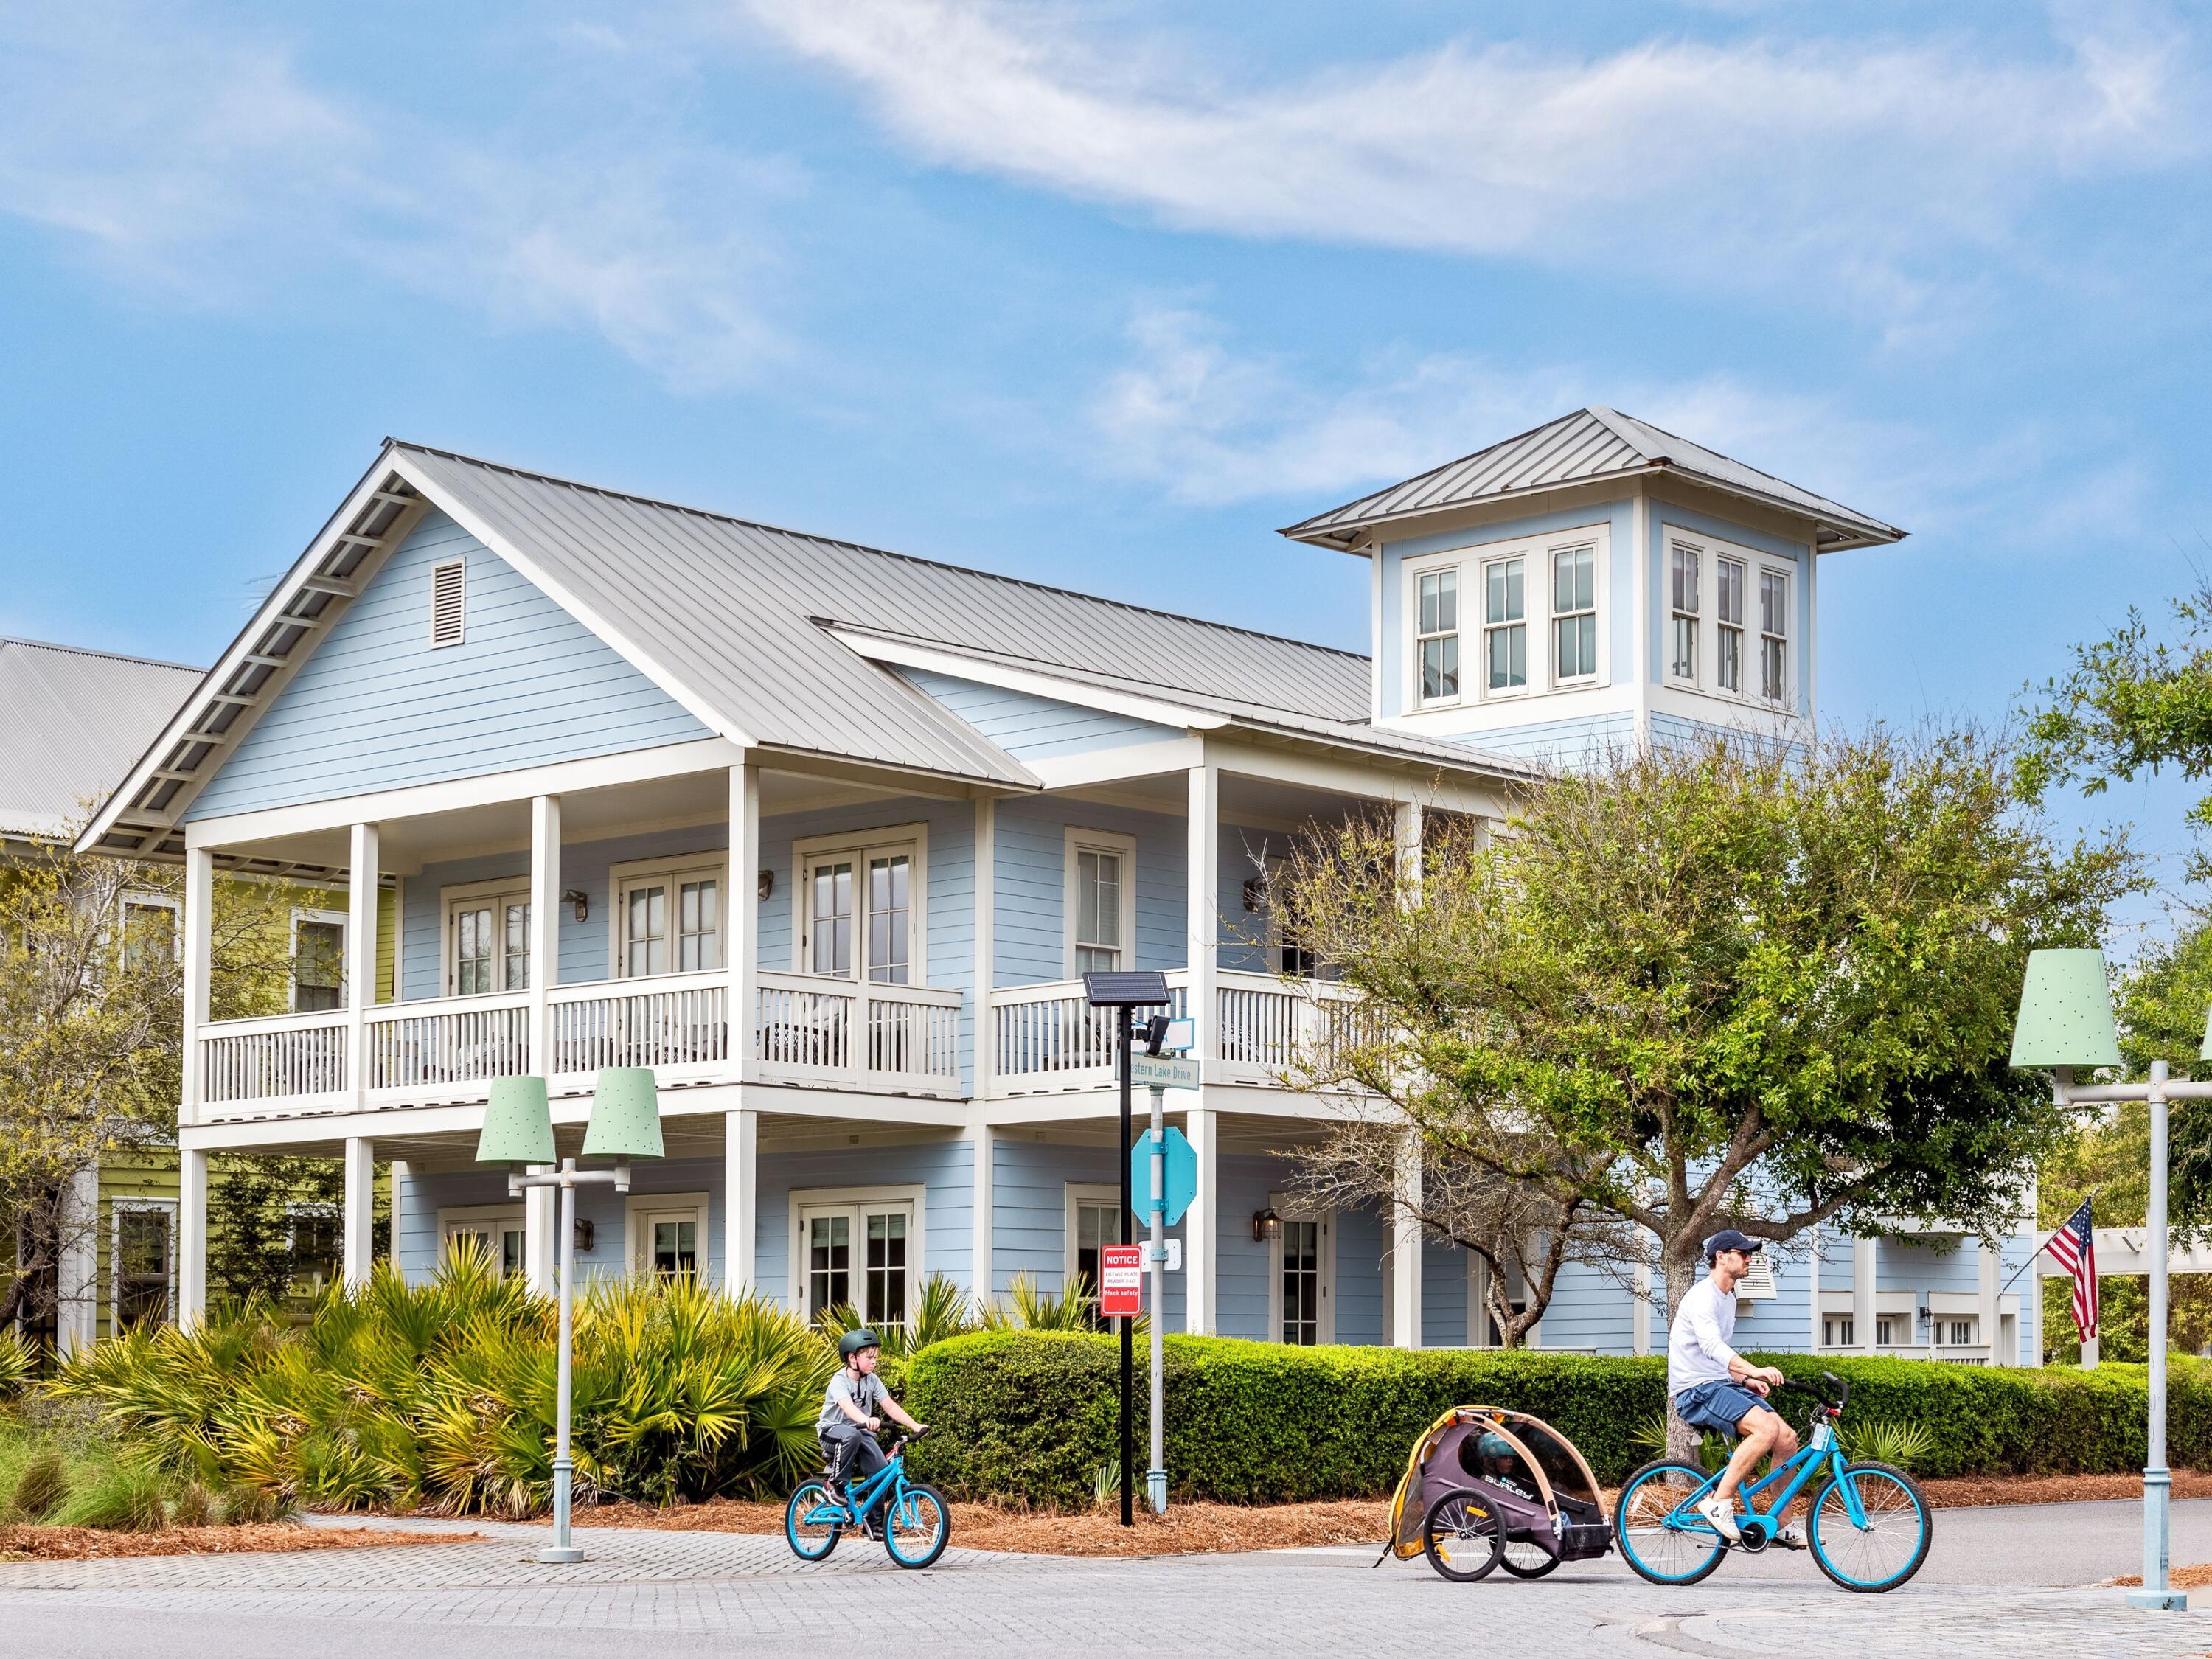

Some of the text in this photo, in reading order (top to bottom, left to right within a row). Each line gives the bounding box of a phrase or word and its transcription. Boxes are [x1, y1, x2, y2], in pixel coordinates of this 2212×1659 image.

[1130, 1062, 1192, 1081] estern Lake Drive
[1107, 1256, 1138, 1264] NOTICE
[1485, 1475, 1533, 1500] BURLEY
